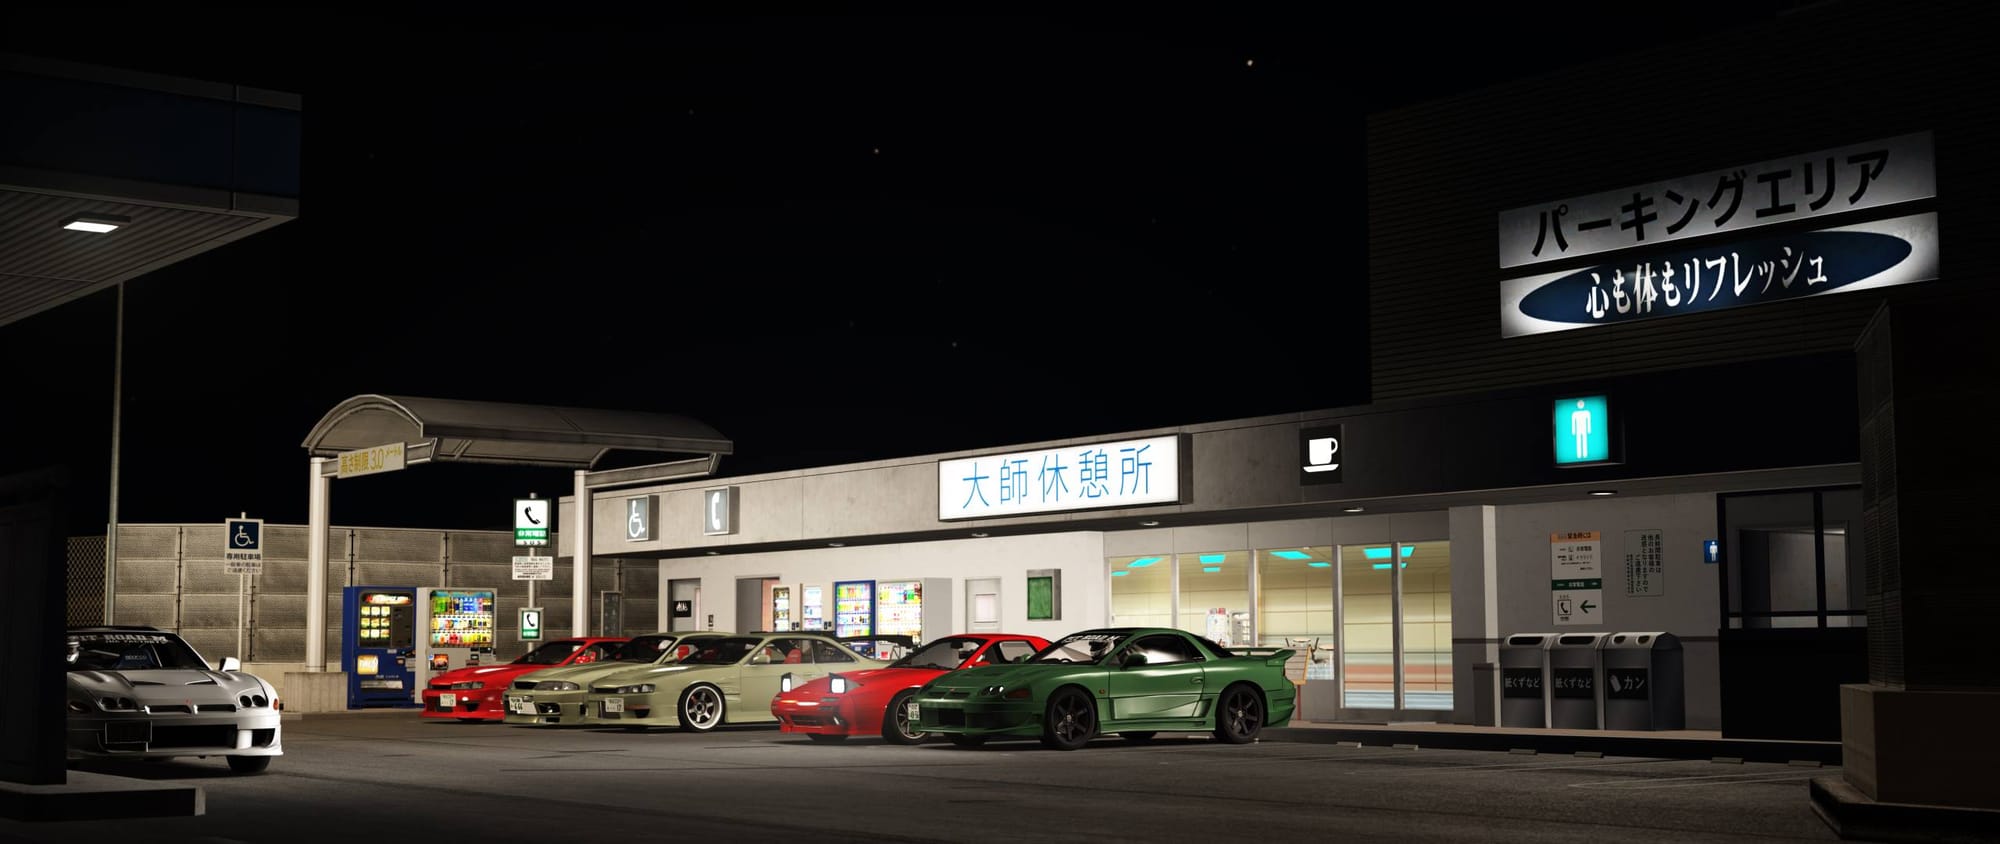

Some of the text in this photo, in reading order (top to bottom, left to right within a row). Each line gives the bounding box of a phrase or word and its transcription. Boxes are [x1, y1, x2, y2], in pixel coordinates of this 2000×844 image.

[1531, 149, 1889, 257] パーキングエリア
[1585, 245, 1829, 319] 心も体もリフレッシュ
[962, 444, 1153, 508] 大師休憩所
[1623, 676, 1645, 690] カン
